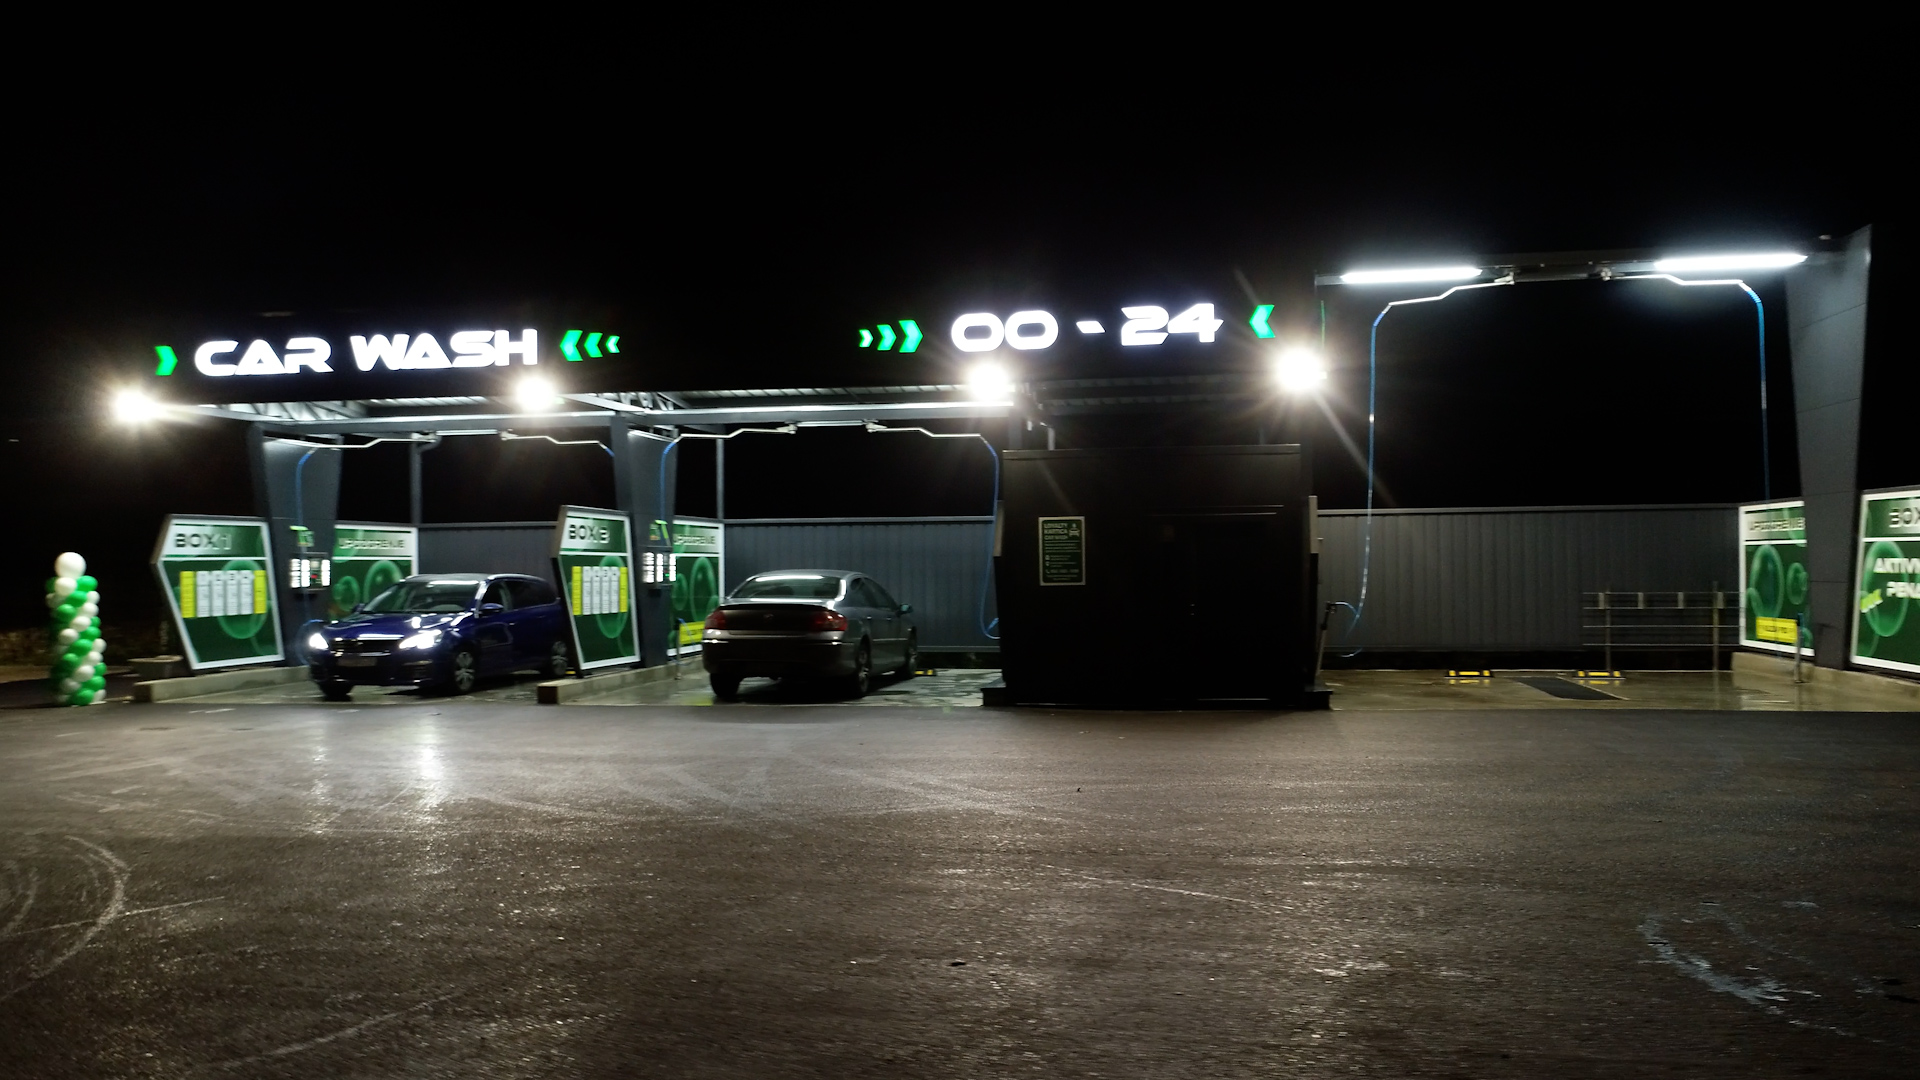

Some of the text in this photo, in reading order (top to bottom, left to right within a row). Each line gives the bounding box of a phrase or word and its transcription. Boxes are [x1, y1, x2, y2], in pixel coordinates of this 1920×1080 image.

[1120, 302, 1224, 347] 24
[193, 327, 539, 377] CAR WASH
[174, 533, 219, 550] BOX
[568, 524, 598, 543] BOX
